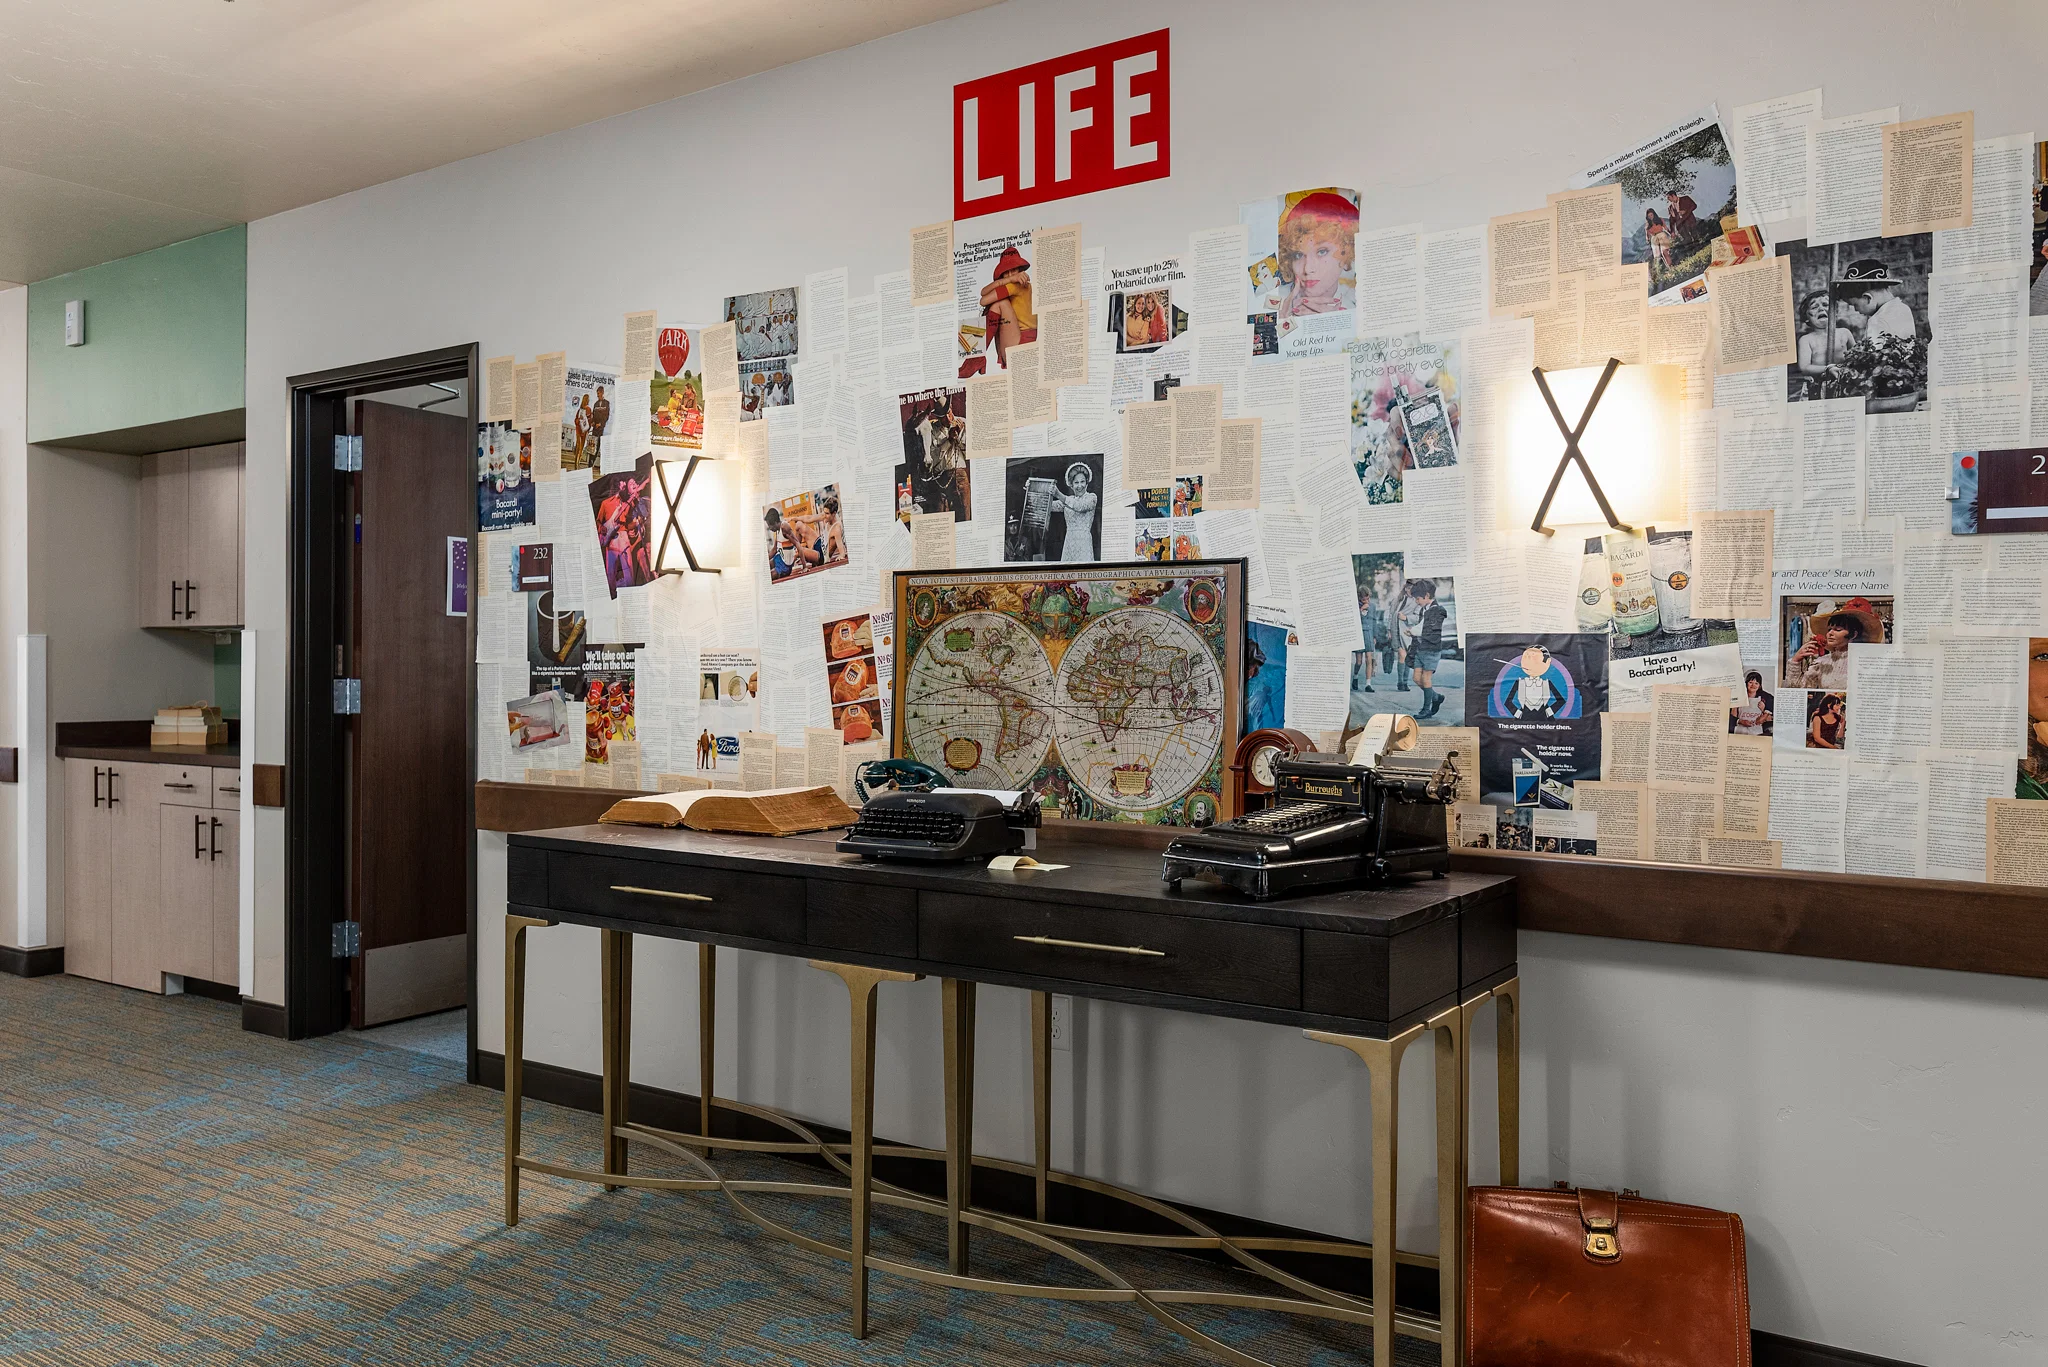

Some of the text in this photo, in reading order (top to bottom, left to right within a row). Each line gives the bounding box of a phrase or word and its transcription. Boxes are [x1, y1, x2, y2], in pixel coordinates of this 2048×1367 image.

[963, 50, 1157, 202] LIFE
[1586, 163, 1609, 178] Spend
[1614, 151, 1635, 165] milder
[1635, 137, 1663, 154] moment
[1664, 130, 1679, 140] with
[1678, 116, 1706, 132] Raleigh.
[963, 239, 990, 250] Presenting
[953, 249, 974, 259] Virginia
[975, 247, 988, 255] Slims
[989, 243, 1005, 252] would
[964, 256, 972, 264] the
[974, 253, 992, 262] English
[1111, 269, 1124, 279] You
[1126, 268, 1142, 277] save
[1144, 265, 1153, 274] up
[1162, 258, 1180, 270] 25%
[1115, 276, 1146, 289] Polaroid
[1147, 273, 1166, 284] color
[1168, 271, 1186, 281] film.
[661, 329, 688, 352] LARK
[1292, 335, 1336, 347] Old Red for
[1347, 338, 1402, 353] Farewell to
[1286, 346, 1323, 358] Young Lips
[1366, 351, 1387, 363] ugly
[1387, 361, 1418, 377] pretty
[568, 371, 581, 380] taste
[582, 373, 592, 382] that
[592, 374, 607, 384] beats
[907, 395, 913, 404] to
[914, 391, 934, 402] where
[935, 388, 945, 397] the
[1411, 405, 1436, 420] eve
[496, 498, 517, 508] Bacardi
[492, 507, 522, 519] mini-party!
[534, 548, 548, 559] 232
[1610, 550, 1644, 561] BACARDI
[1015, 572, 1065, 581] GEOGRAPHICA
[1078, 571, 1141, 579] HYDROGRAPHICA
[1854, 569, 1875, 577] with
[1780, 582, 1795, 590] the
[1798, 582, 1857, 590] Wide-Screen
[585, 651, 600, 660] We'll
[601, 651, 616, 660] take
[1643, 656, 1667, 667] Have
[582, 662, 602, 671] coffee
[603, 662, 609, 670] in
[610, 661, 620, 670] the
[1628, 661, 1696, 679] Bacardi party!
[1305, 782, 1342, 795] Burroughs
